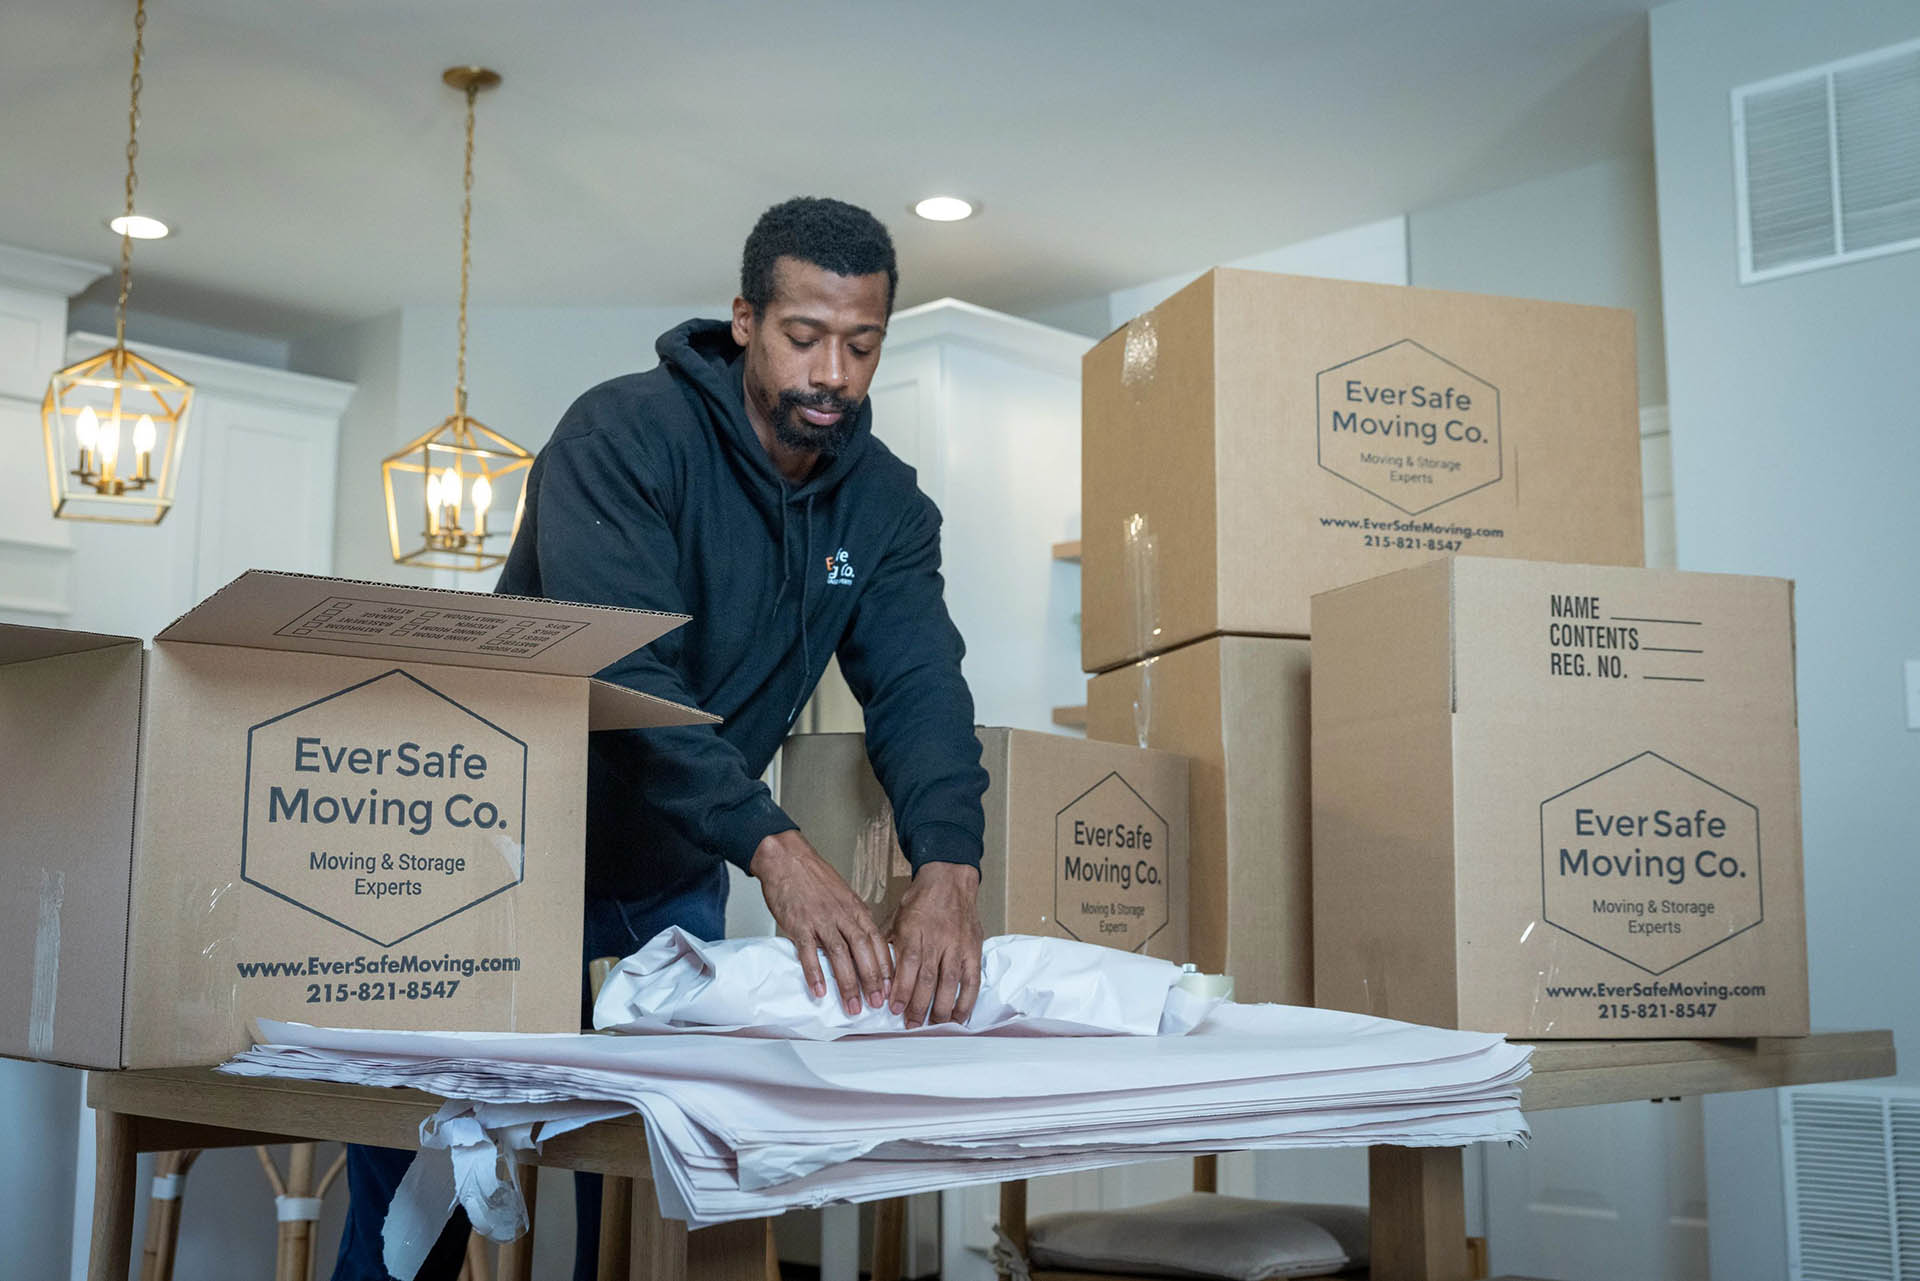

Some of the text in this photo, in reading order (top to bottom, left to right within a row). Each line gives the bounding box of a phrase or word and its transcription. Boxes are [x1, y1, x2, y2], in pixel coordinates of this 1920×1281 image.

[1346, 380, 1472, 411] EverSafe
[1332, 410, 1488, 445] Moving Co.
[1360, 453, 1461, 471] Moving & Storage
[1390, 471, 1433, 484] Experts
[1320, 517, 1504, 539] www.EverSafeMoving.com
[1364, 535, 1462, 552] 215-821-8547
[1550, 595, 1600, 619] NAME
[1550, 623, 1638, 650] CONTENTS
[1551, 653, 1628, 679] REG. NO.
[294, 736, 487, 780] EverSafe
[268, 786, 507, 835] Moving Co.
[1575, 808, 1726, 838] EverSafe
[1074, 820, 1152, 850] EverSafe
[309, 852, 466, 875] Moving & Storage
[1064, 856, 1162, 890] Moving Co.
[1560, 848, 1746, 885] Moving Co.
[354, 878, 422, 899] Experts
[1081, 902, 1145, 919] Moving & Storage
[1592, 899, 1715, 917] Moving & Storage
[1100, 920, 1128, 934] Experts
[1628, 920, 1681, 936] Experts
[237, 954, 520, 978] www.EverSafeMoving.com
[306, 980, 460, 1003] 215-821-8547
[1546, 982, 1766, 1000] www.EverSafeMoving.com
[1598, 1003, 1718, 1019] 215-821-8547
